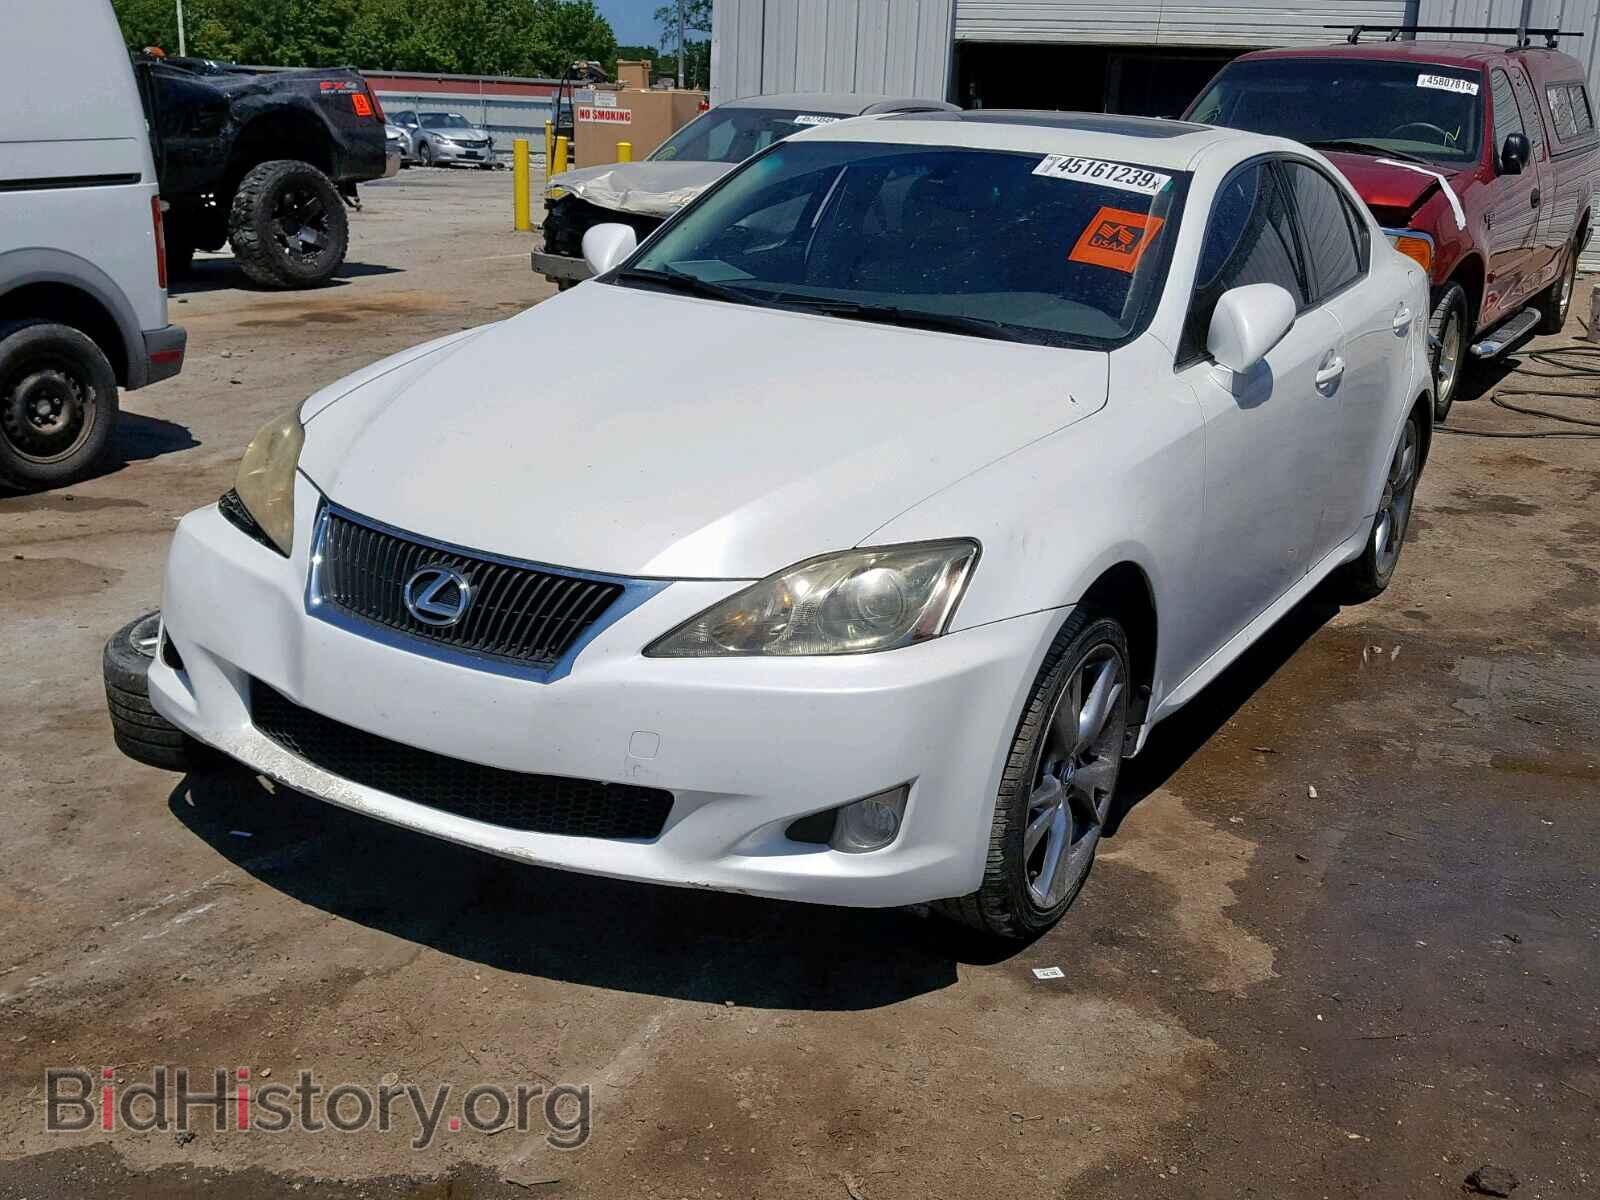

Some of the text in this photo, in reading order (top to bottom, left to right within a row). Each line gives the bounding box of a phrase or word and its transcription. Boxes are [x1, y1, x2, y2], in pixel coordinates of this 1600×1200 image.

[579, 109, 631, 122] NO SMOKING
[1091, 236, 1127, 252] USAA
